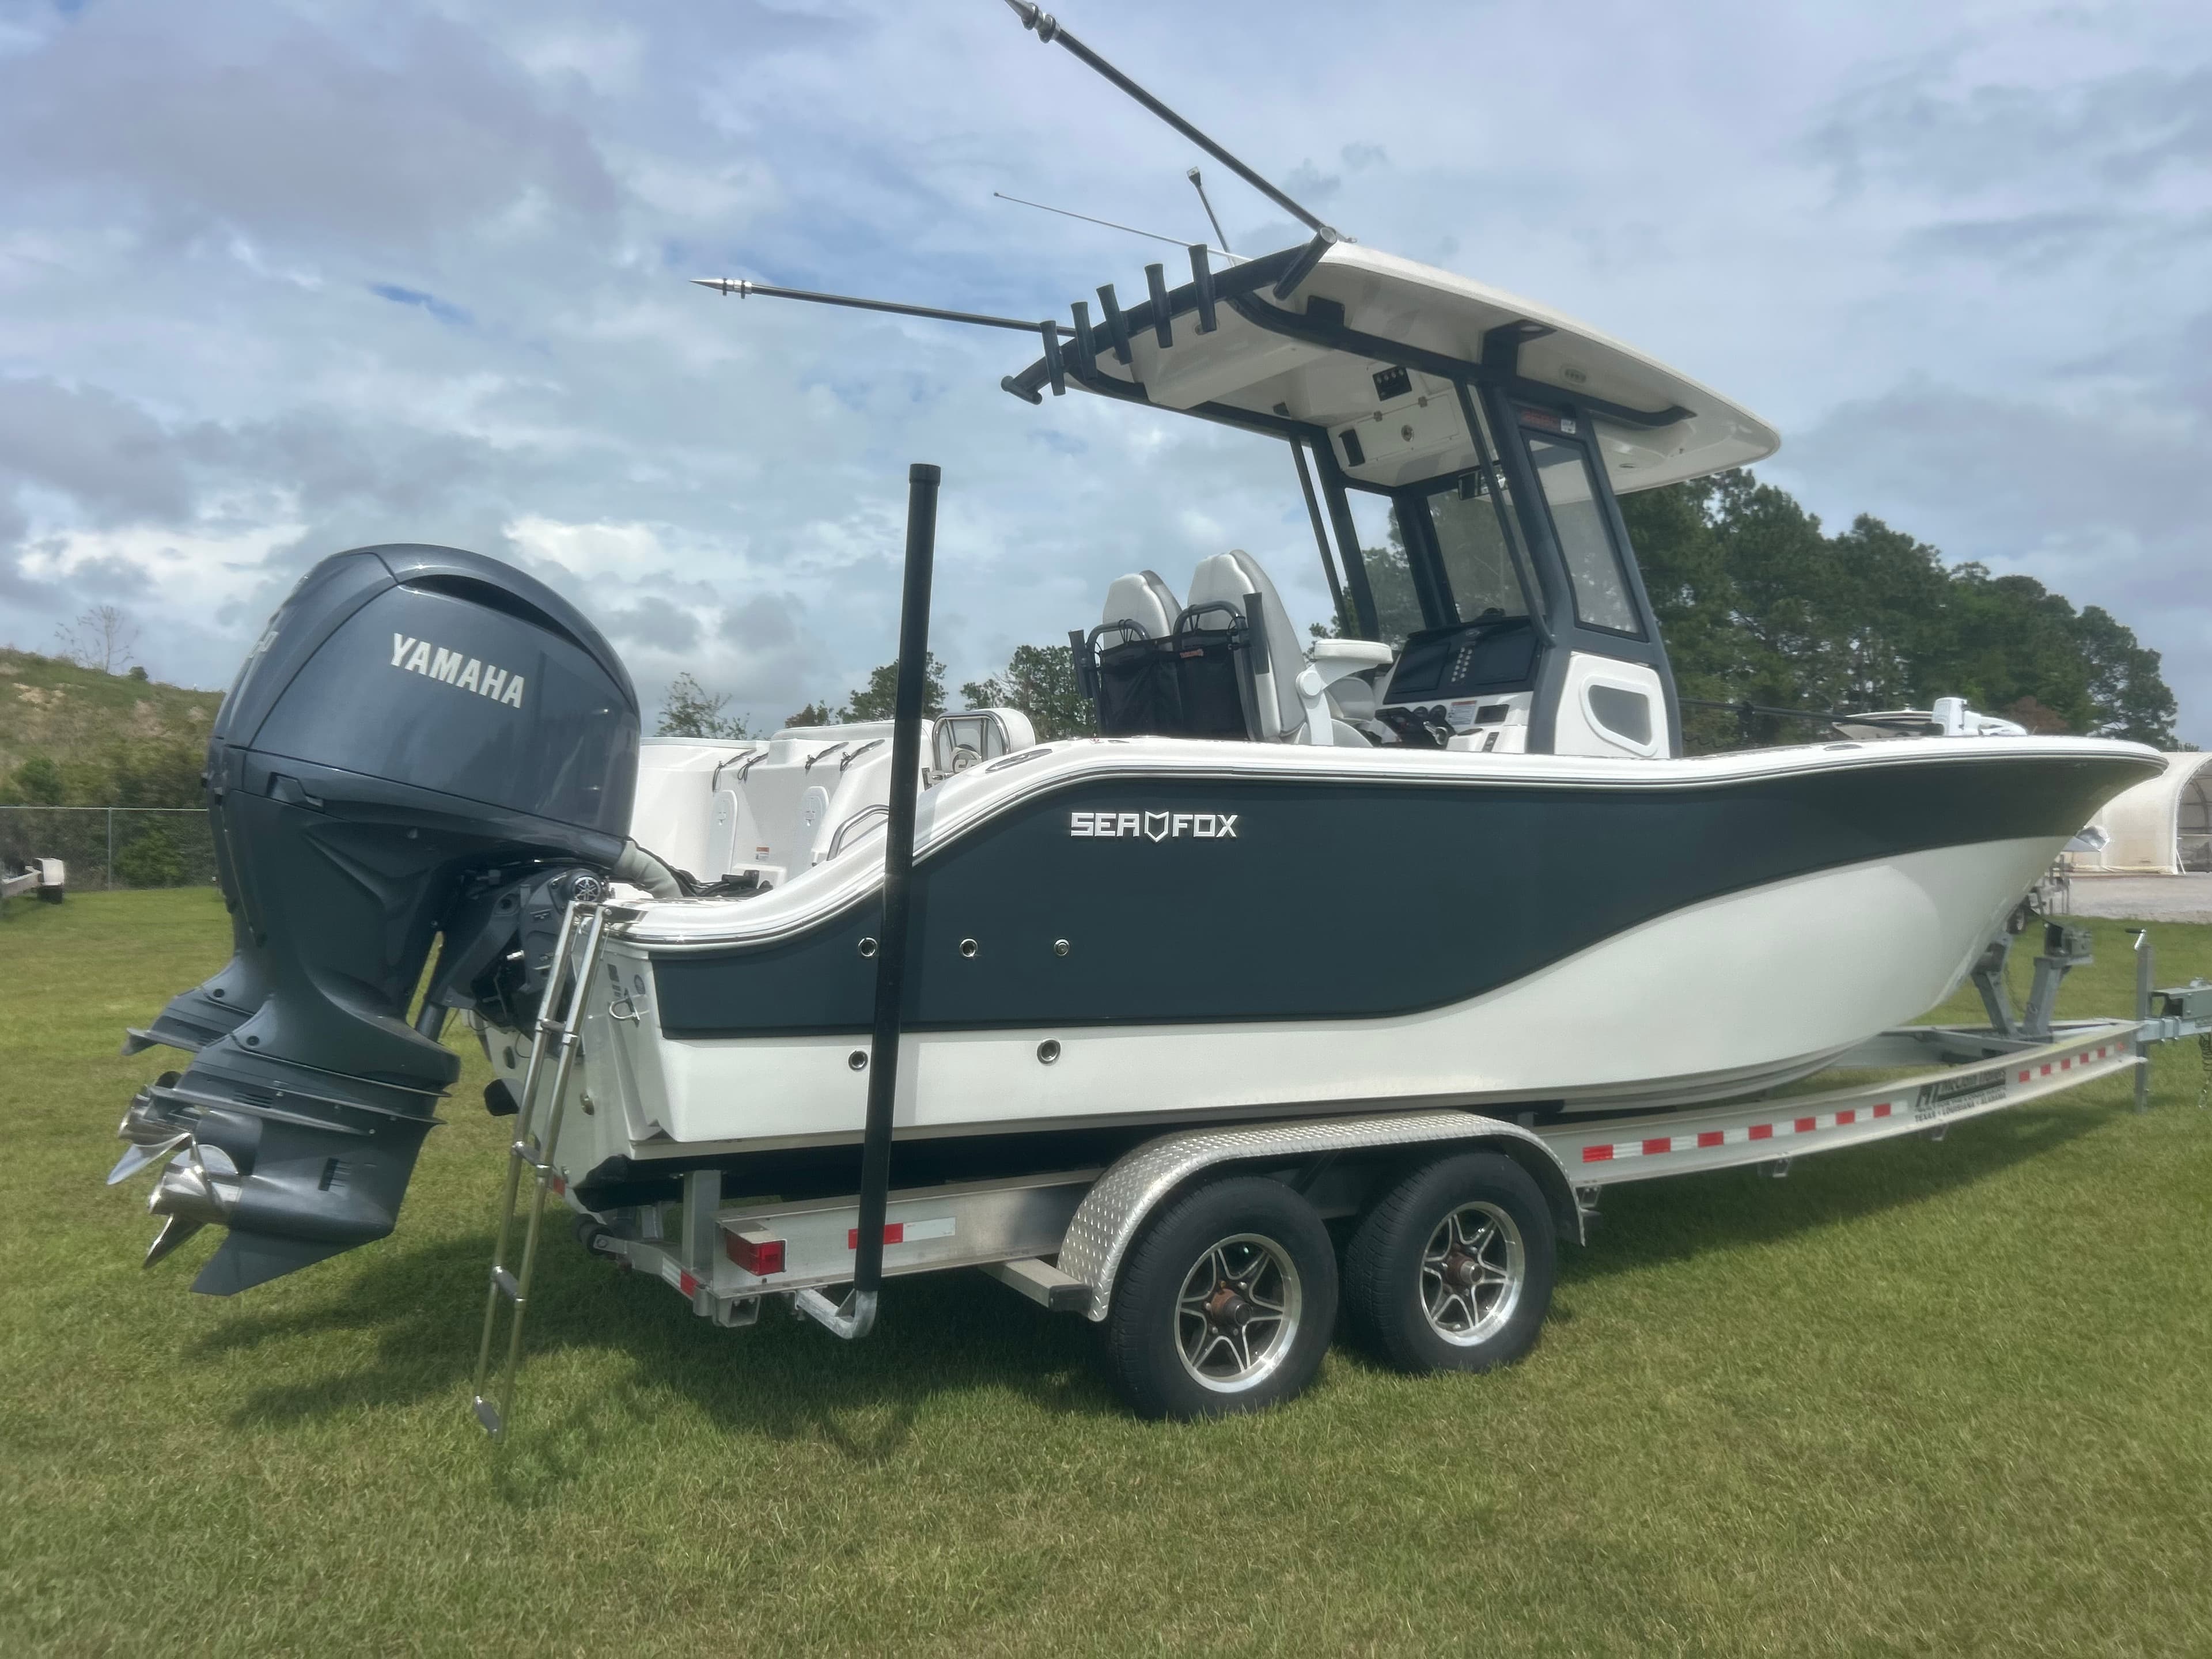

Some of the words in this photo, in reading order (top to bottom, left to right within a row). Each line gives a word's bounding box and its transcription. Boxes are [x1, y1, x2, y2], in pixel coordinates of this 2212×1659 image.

[391, 632, 525, 709] YAMAHA
[1071, 812, 1140, 837] SEA
[1172, 814, 1238, 838] FOX
